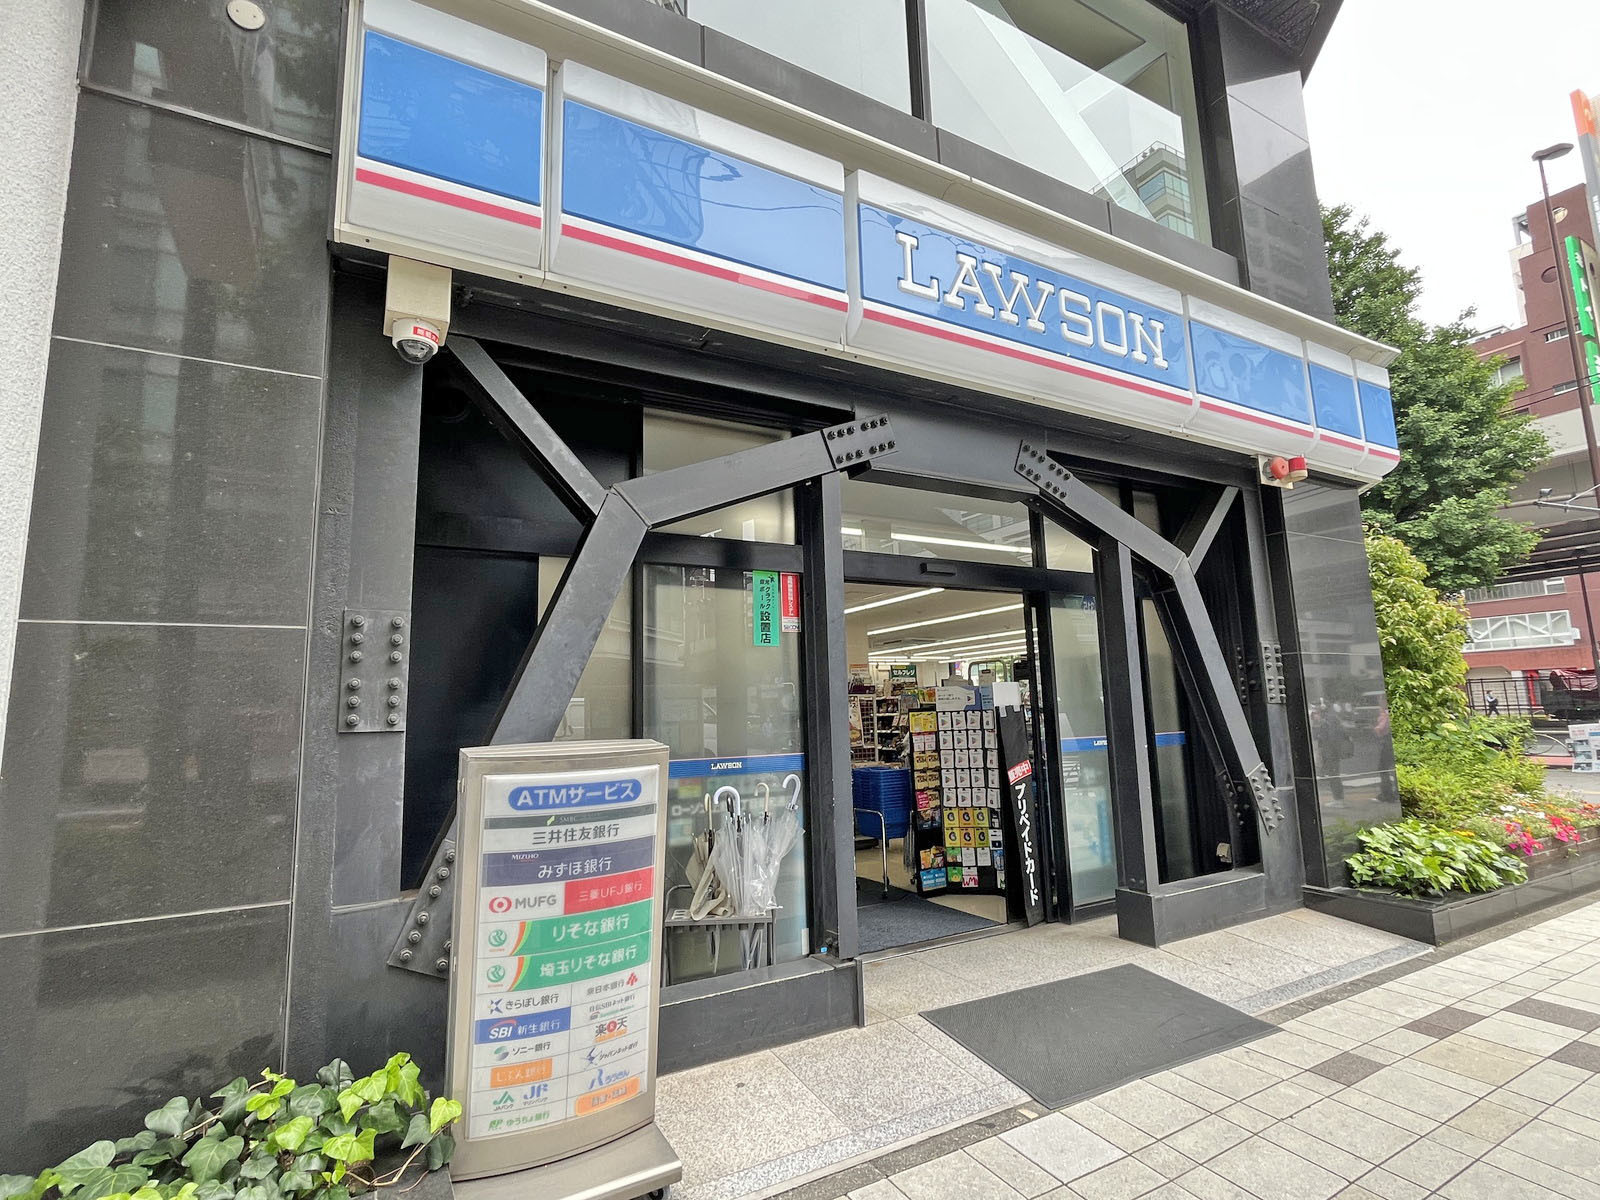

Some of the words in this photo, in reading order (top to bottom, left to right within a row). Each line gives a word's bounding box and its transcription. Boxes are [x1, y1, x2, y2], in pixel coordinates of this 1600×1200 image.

[895, 231, 1169, 370] LAWSON
[711, 761, 742, 770] LAWSON
[516, 782, 636, 807] ATMサービス
[532, 823, 620, 845] 三井住友銀行
[1015, 783, 1039, 906] プリペイドカード
[538, 856, 612, 879] みずほ銀行
[514, 894, 557, 910] MUFG
[552, 913, 630, 942] りそな銀行
[539, 944, 637, 977] 埼玉りそな銀行
[505, 993, 559, 1010] きらぼし銀行
[488, 1026, 513, 1040] SBI
[517, 1019, 560, 1036] 新生銀行
[512, 1041, 551, 1056] ソニー銀行
